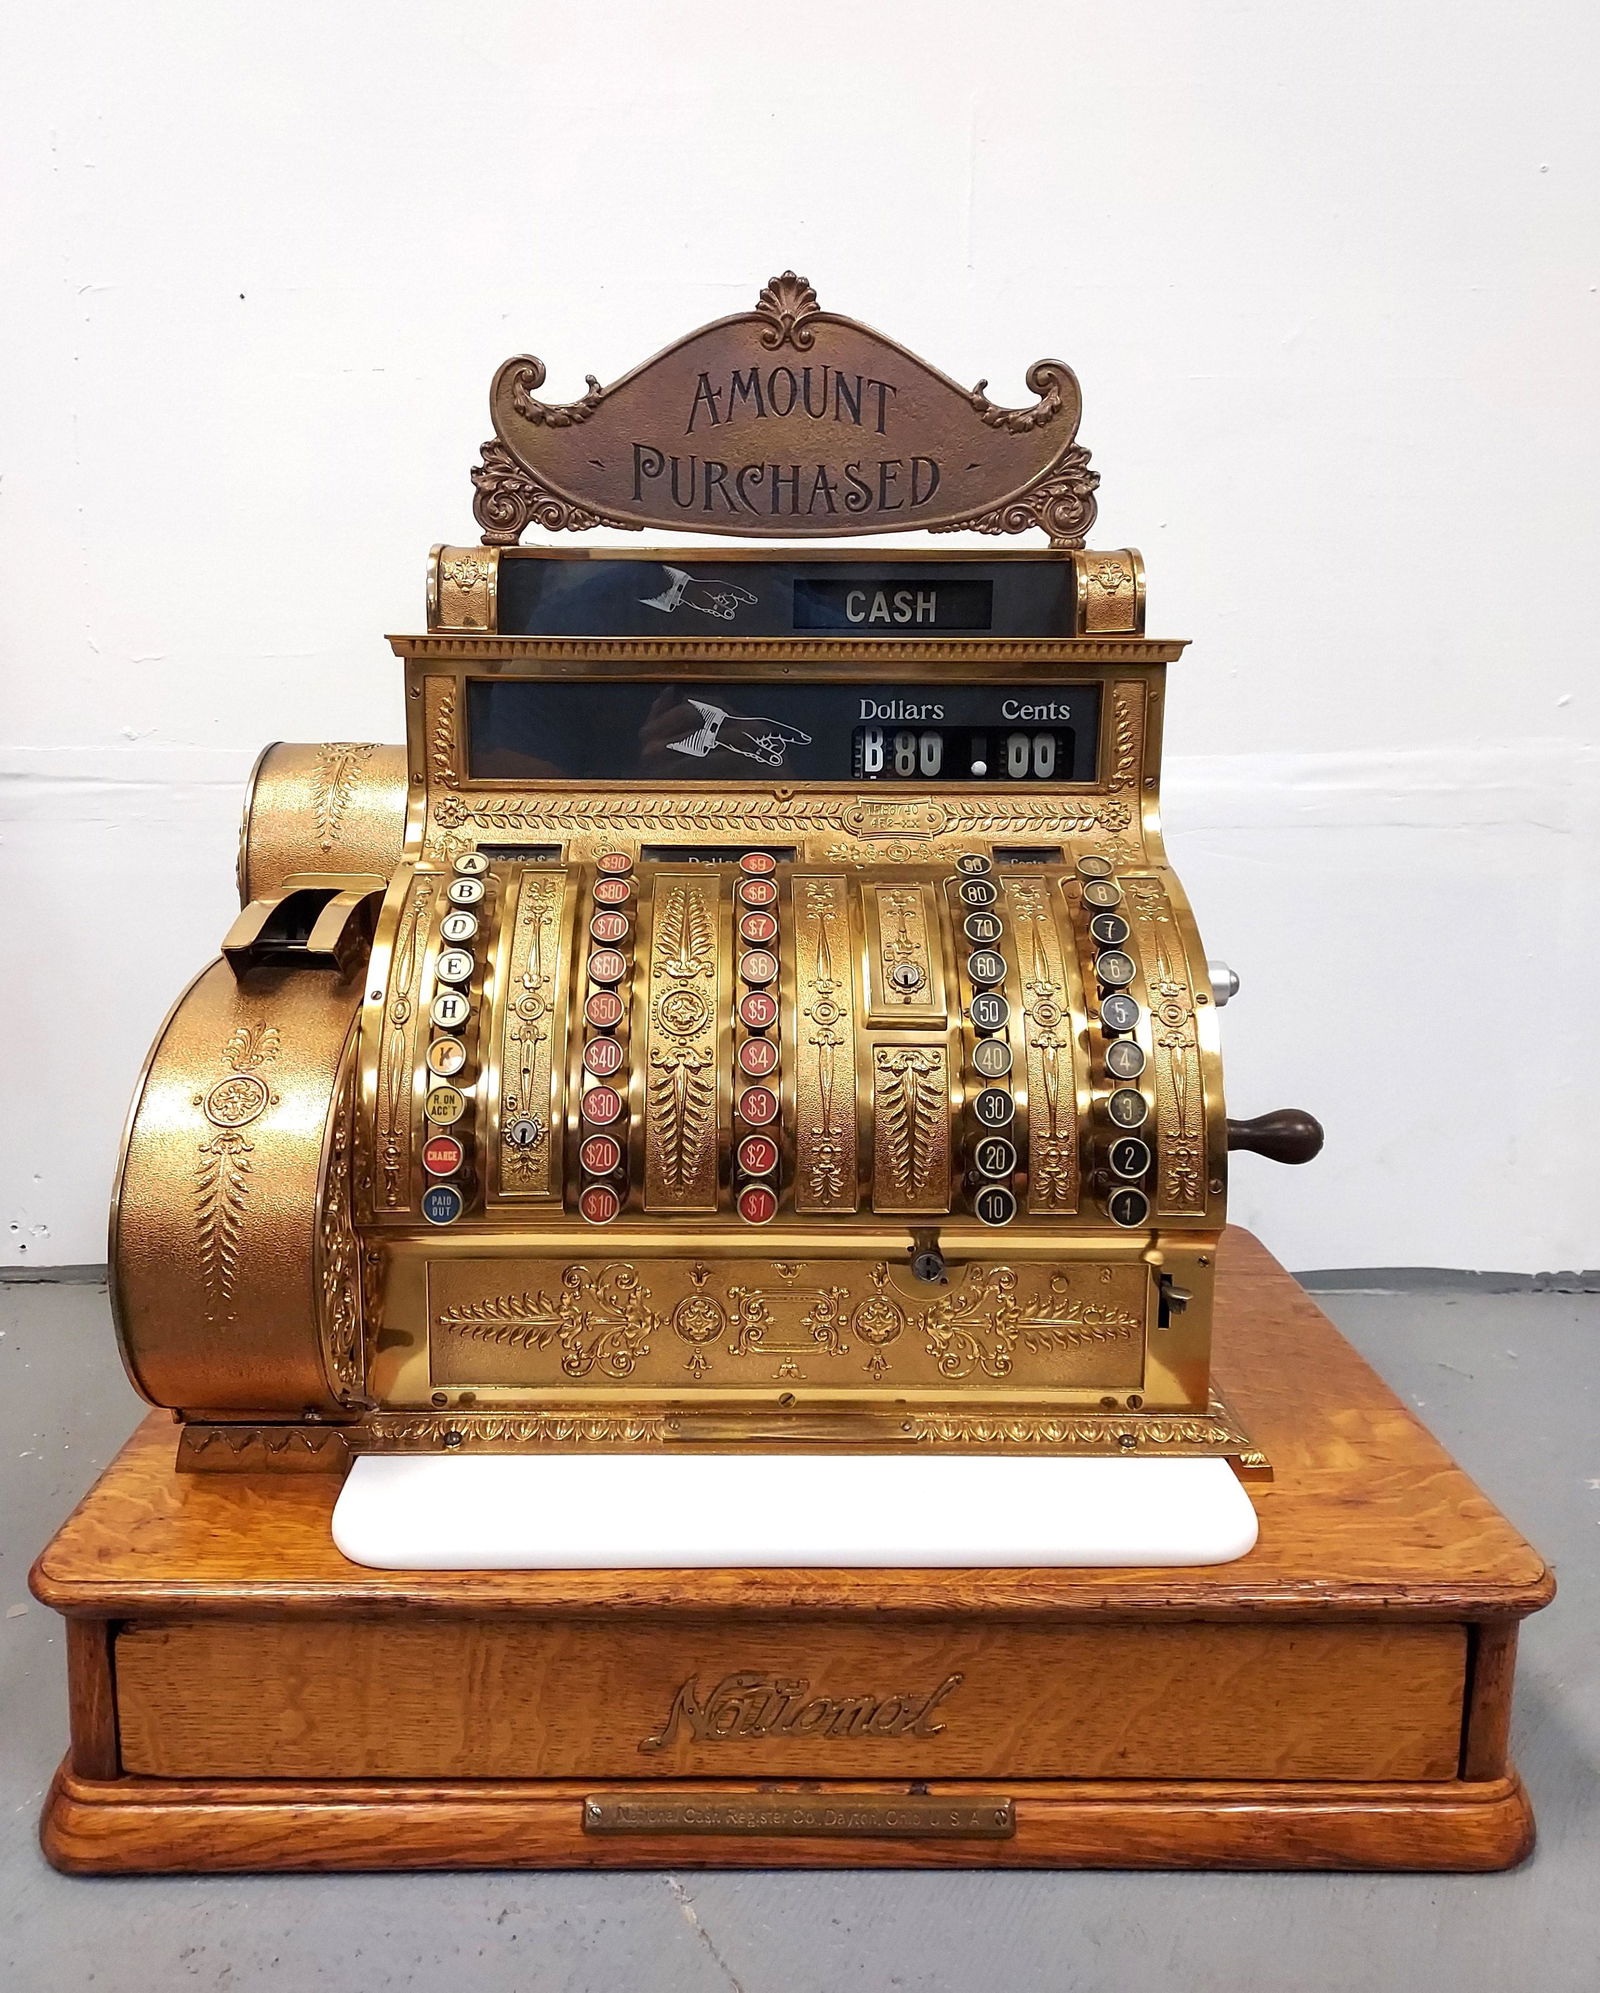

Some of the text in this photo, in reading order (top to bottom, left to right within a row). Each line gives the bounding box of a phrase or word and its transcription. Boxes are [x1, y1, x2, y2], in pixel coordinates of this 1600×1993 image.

[684, 364, 897, 436] AMOUNT
[631, 442, 940, 517] PURCHASED
[845, 590, 936, 623] CASH
[859, 699, 1071, 720] Dollars Cents
[463, 858, 478, 870] A
[602, 857, 626, 869] $90
[750, 858, 766, 871] $9
[964, 858, 982, 872] 90
[458, 885, 473, 898] B
[600, 885, 623, 899] $80
[749, 886, 767, 901] $8
[967, 886, 987, 902] 80
[1097, 886, 1107, 902] 8
[451, 919, 467, 934] D
[597, 919, 622, 936] $70
[749, 919, 767, 937] $7
[974, 919, 994, 937] 70
[1104, 921, 1115, 939] 7
[447, 958, 462, 975] E
[593, 956, 618, 976] $60
[749, 957, 768, 977] $6
[977, 957, 996, 977] 60
[1111, 959, 1121, 978] 6
[441, 1000, 457, 1018] H
[591, 999, 616, 1020] $50
[748, 999, 767, 1021] $5
[979, 1000, 999, 1023] 50
[1114, 1002, 1126, 1024] 5
[590, 1046, 615, 1068] $40
[749, 1046, 768, 1067] $4
[982, 1047, 1003, 1070] 40
[1120, 1047, 1131, 1071] 4
[444, 1095, 455, 1105] ON
[588, 1094, 614, 1117] $30
[748, 1094, 767, 1117] $3
[985, 1095, 1004, 1119] 30
[1123, 1098, 1132, 1120] 3
[427, 1150, 458, 1162] CHARGE
[586, 1143, 612, 1167] $20
[747, 1145, 765, 1168] $2
[986, 1146, 1005, 1170] 20
[1125, 1147, 1134, 1170] 2
[432, 1195, 451, 1206] PAID
[588, 1195, 612, 1218] $10
[748, 1195, 765, 1217] $1
[986, 1196, 1003, 1219] 10
[1124, 1197, 1132, 1220] 1
[432, 1206, 450, 1217] OUT
[637, 1670, 965, 1752] National
